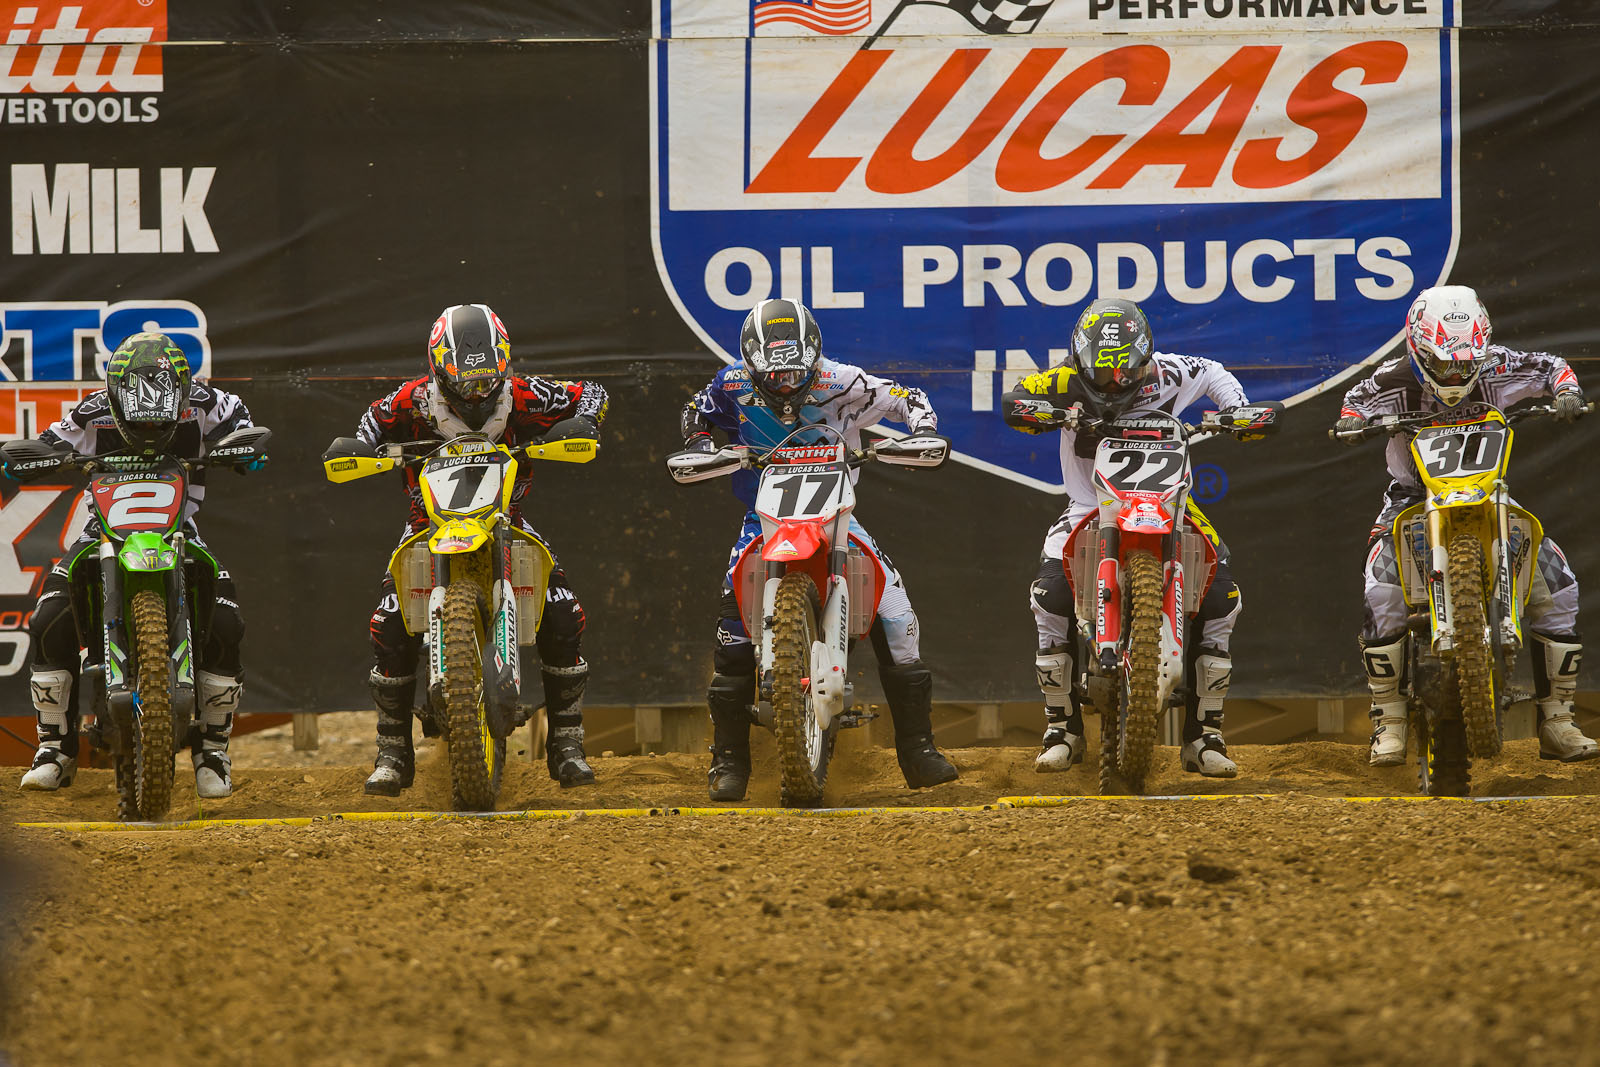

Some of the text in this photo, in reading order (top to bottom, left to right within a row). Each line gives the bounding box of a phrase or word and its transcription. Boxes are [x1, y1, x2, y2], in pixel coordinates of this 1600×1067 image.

[1089, 0, 1426, 20] PERFORMANCE
[52, 97, 160, 124] TOOLS
[744, 40, 1408, 195] LUCAS
[11, 162, 220, 255] MILK
[704, 236, 1415, 311] OIL PRODUCTS
[1449, 313, 1468, 321] Arai
[0, 300, 212, 382] TS
[1123, 442, 1163, 450] LUCAS OIL
[1439, 424, 1481, 436] LUCAS OIL
[13, 458, 61, 471] ACERBIS
[209, 446, 255, 457] ACERBIS
[443, 455, 489, 468] LUCAS OIL
[813, 465, 827, 473] OIL
[1426, 431, 1504, 478] 30
[118, 474, 144, 482] LUCAS
[447, 465, 490, 510] 1
[1107, 450, 1185, 493] 22
[107, 482, 176, 529] 2
[772, 473, 841, 518] 17
[1174, 580, 1183, 640] DUNLOP
